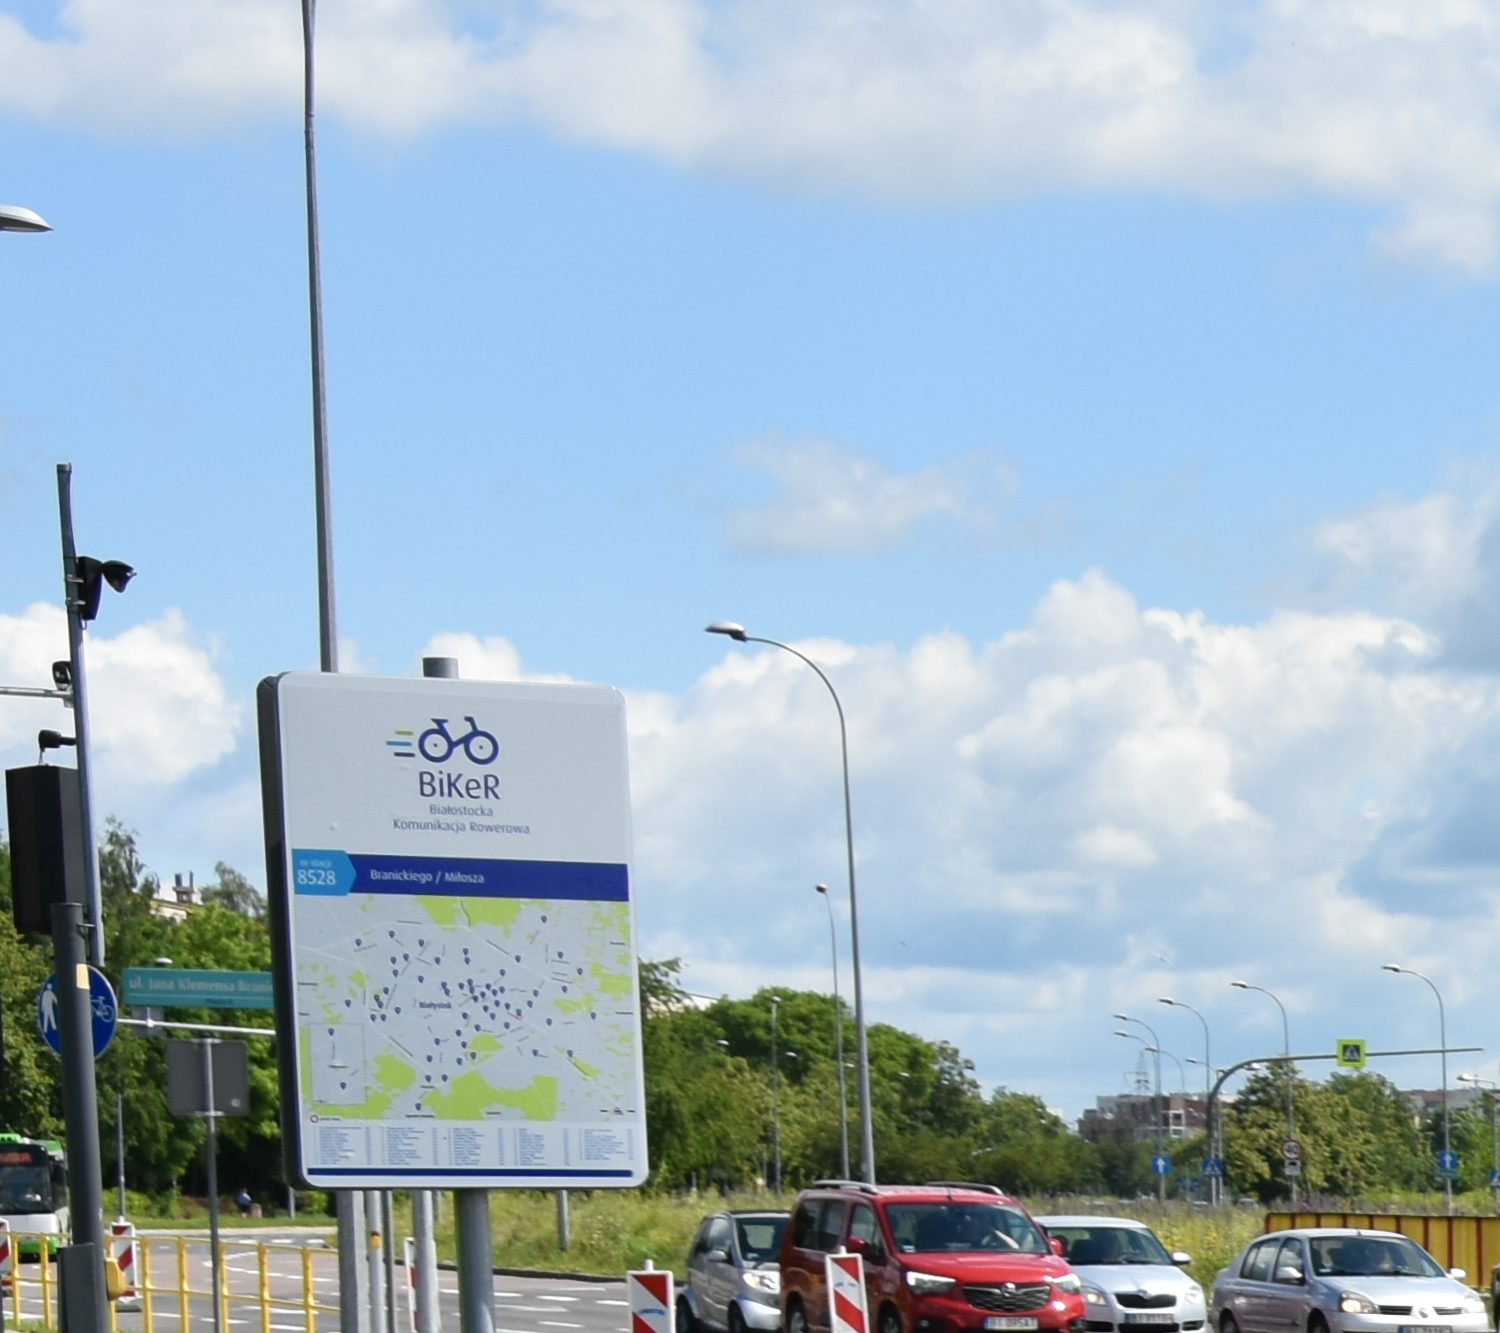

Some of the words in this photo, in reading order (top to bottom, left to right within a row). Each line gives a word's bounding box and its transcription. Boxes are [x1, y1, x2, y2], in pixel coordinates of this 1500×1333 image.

[419, 769, 501, 800] BiKeR
[429, 803, 494, 817] Białostocka
[393, 818, 466, 834] Komunikacja
[469, 821, 531, 834] Rowerowa
[297, 869, 336, 885] 8528
[370, 869, 433, 884] Branickiego
[444, 871, 485, 884] Miłosza
[148, 978, 175, 990] Jana
[178, 978, 235, 991] Klemensa
